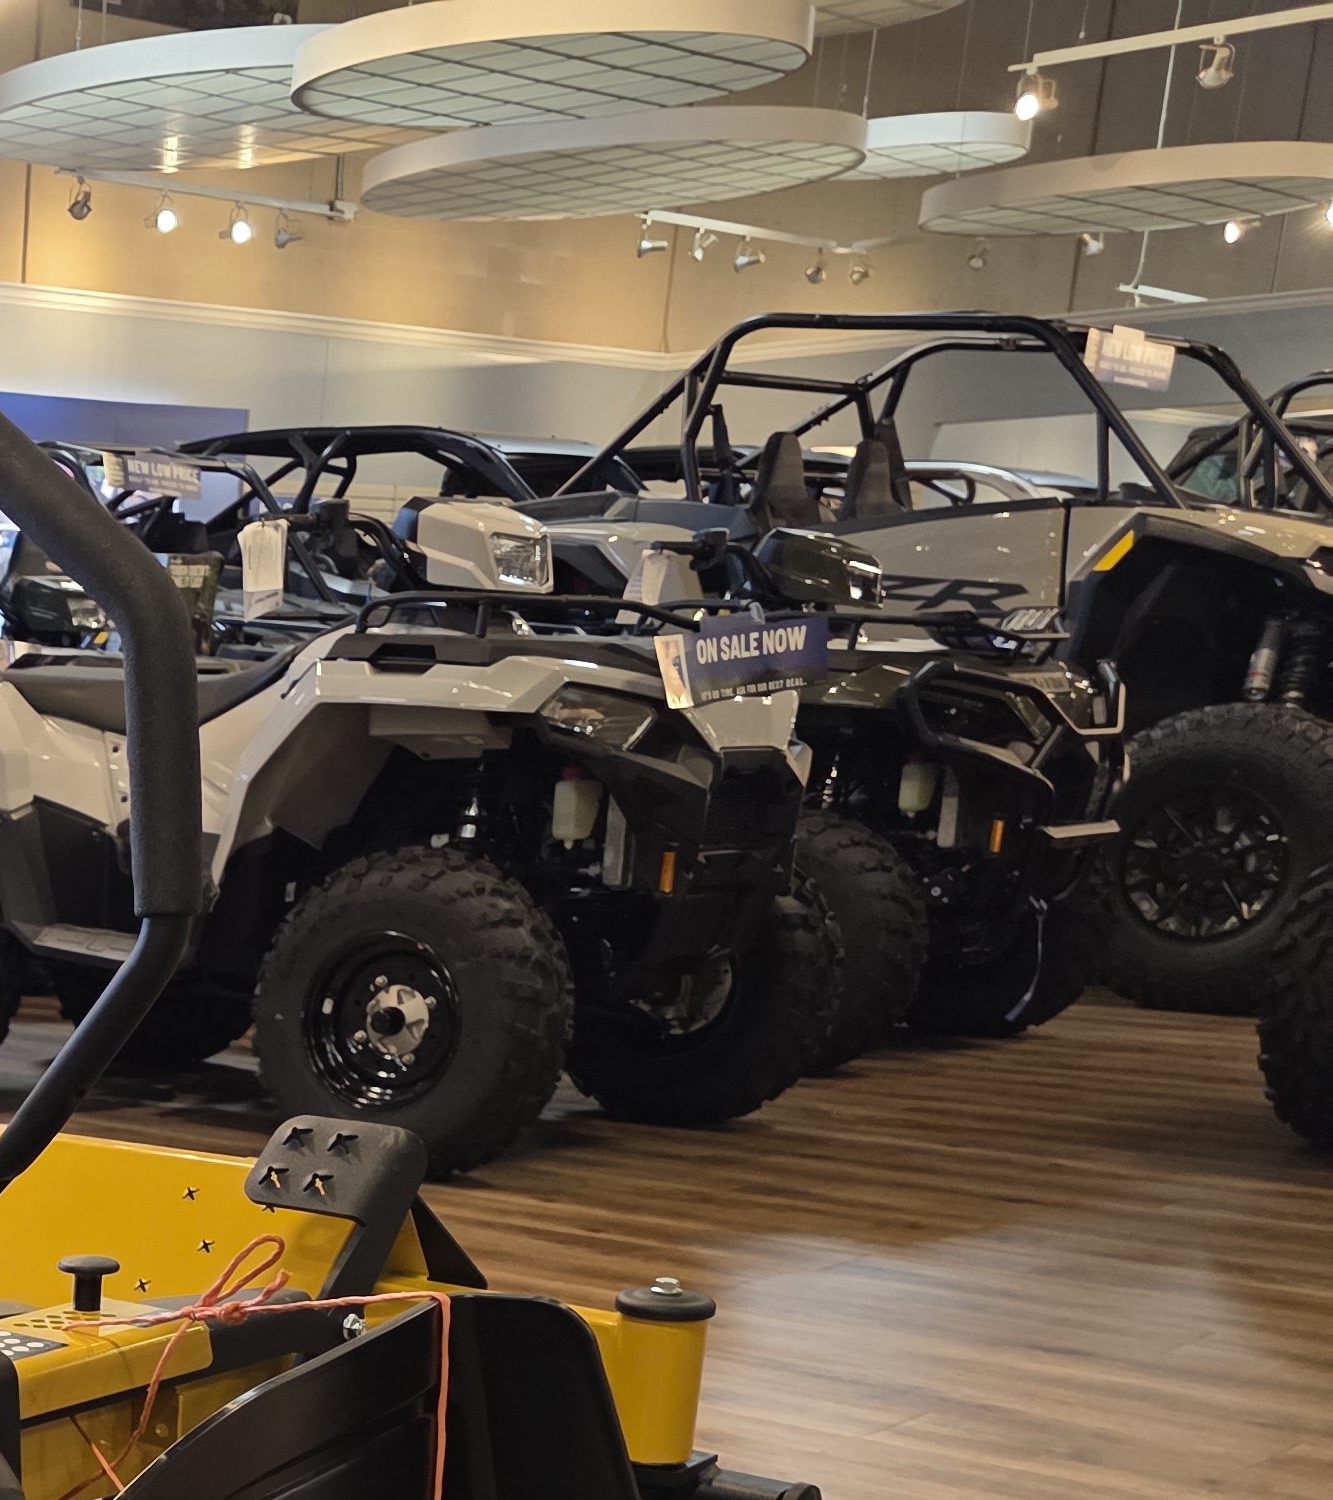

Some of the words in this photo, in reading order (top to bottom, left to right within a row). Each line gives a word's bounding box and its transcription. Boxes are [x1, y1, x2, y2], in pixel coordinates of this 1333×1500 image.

[127, 459, 149, 475] NEW
[151, 462, 171, 478] LOW
[173, 465, 200, 483] PRICE
[696, 637, 718, 665] ON
[720, 631, 760, 661] SALE
[762, 625, 807, 651] NOW
